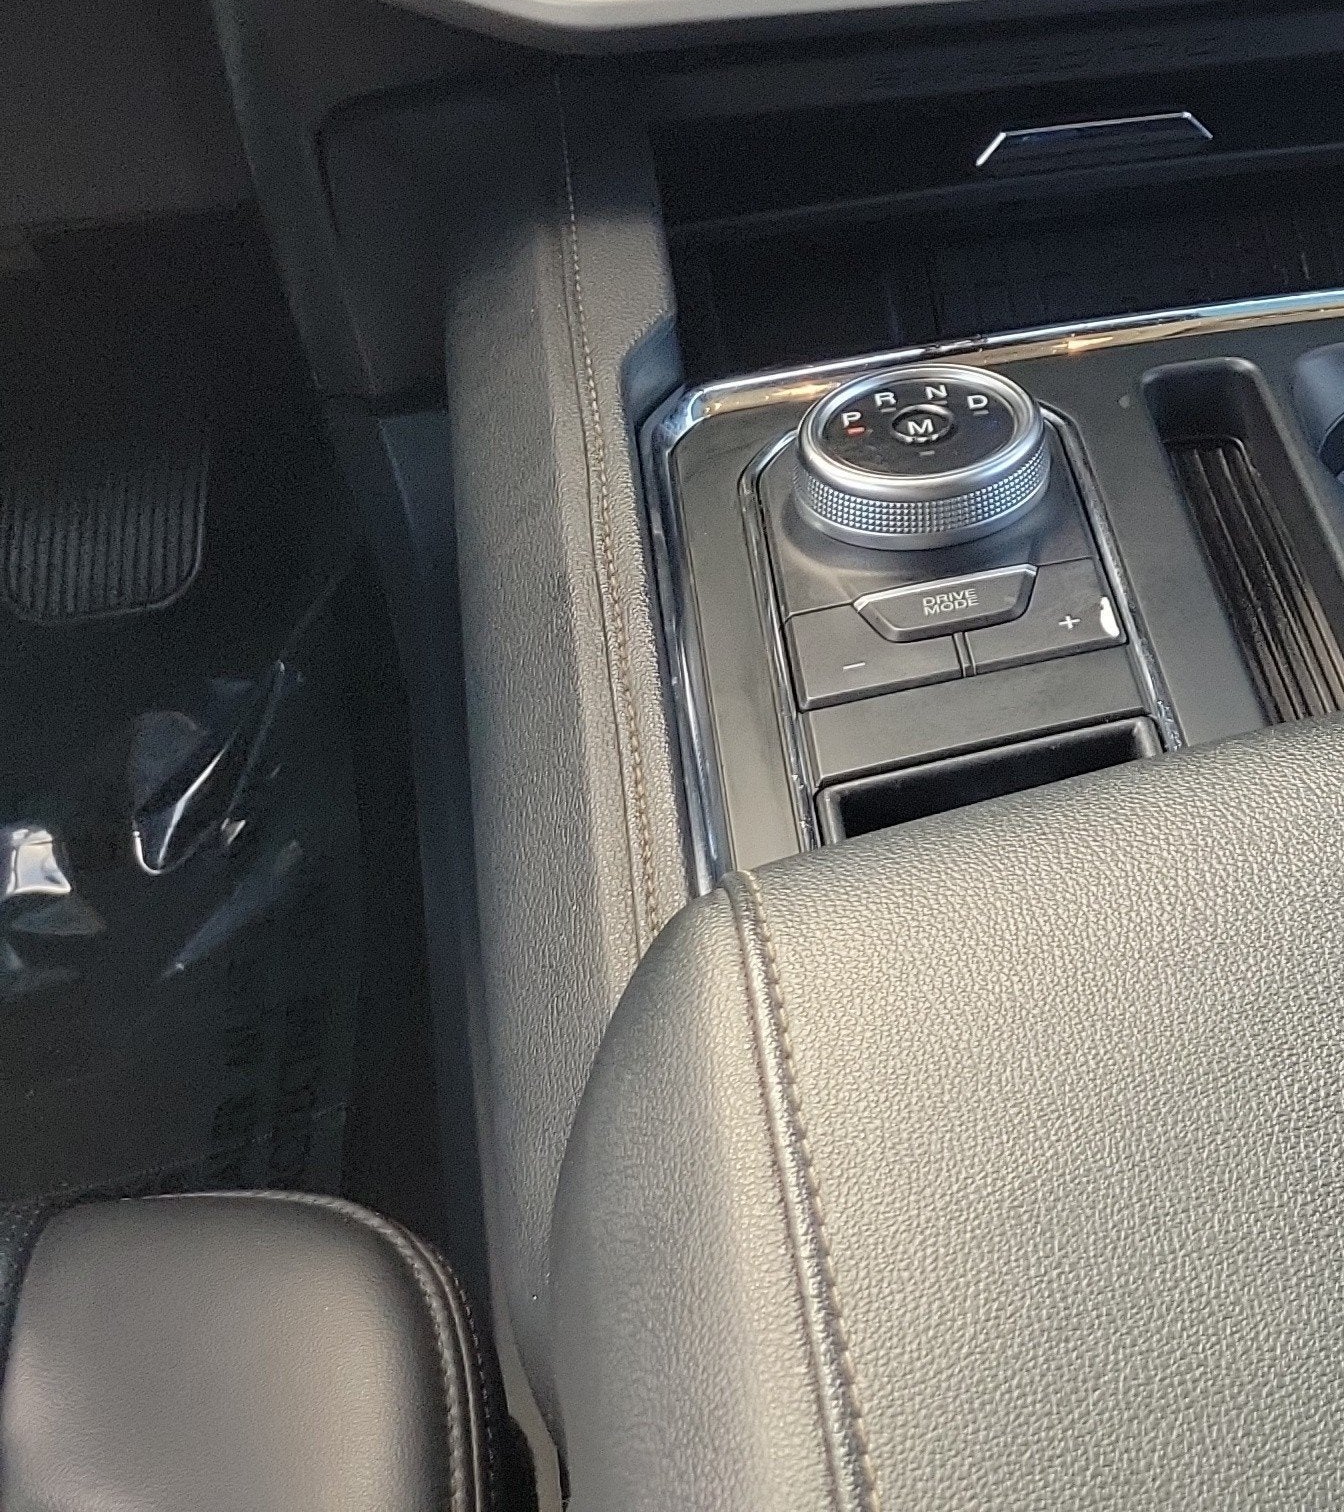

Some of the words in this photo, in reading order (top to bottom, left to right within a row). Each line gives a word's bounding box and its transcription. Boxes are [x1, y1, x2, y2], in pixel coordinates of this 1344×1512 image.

[841, 411, 862, 426] P
[873, 391, 897, 408] R
[925, 384, 948, 400] N
[967, 394, 989, 410] D
[907, 418, 935, 435] M
[922, 588, 977, 607] DRIVE
[923, 595, 979, 617] MODE
